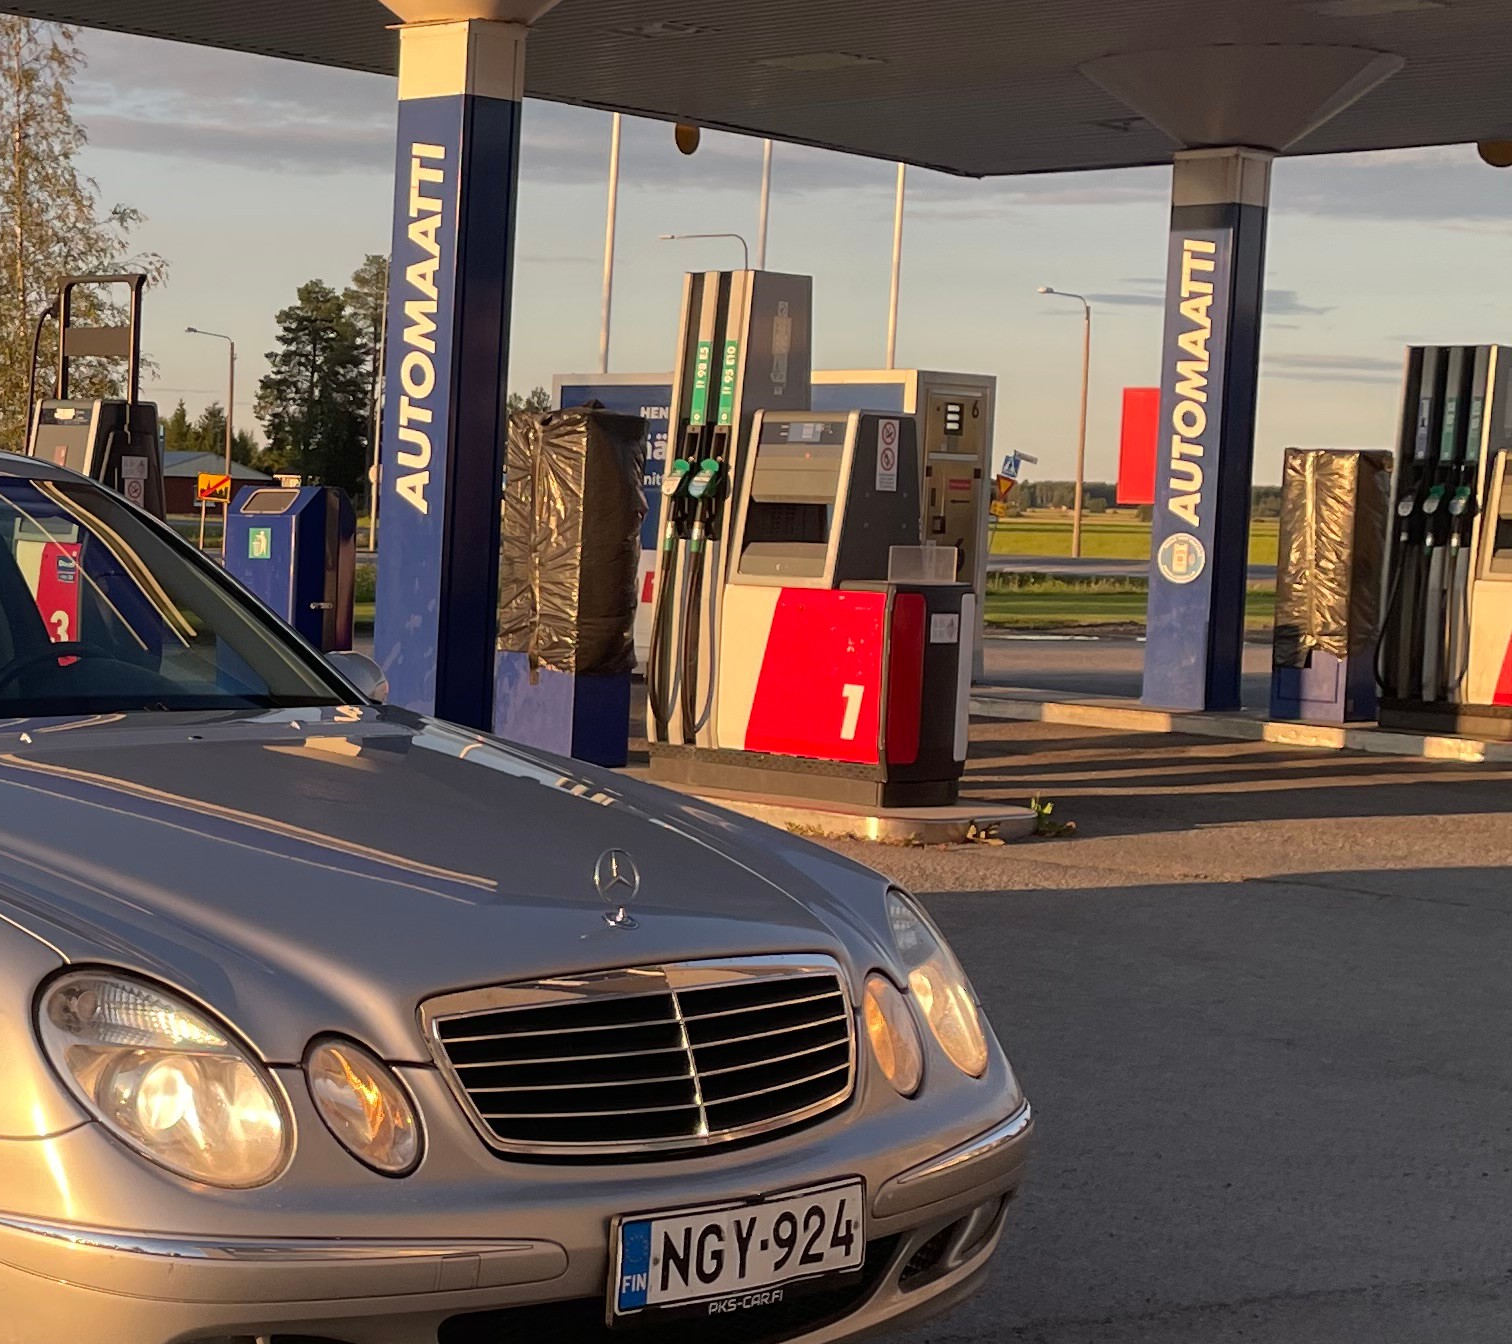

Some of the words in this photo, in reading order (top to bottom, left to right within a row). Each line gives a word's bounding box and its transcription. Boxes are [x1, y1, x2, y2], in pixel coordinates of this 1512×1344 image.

[396, 142, 445, 515] AUTOMAATTI
[1168, 239, 1216, 527] AUTOMAATTI
[50, 610, 69, 643] 3
[840, 683, 865, 740] 1
[621, 1272, 647, 1294] FIN
[660, 1199, 855, 1292] NGY-924
